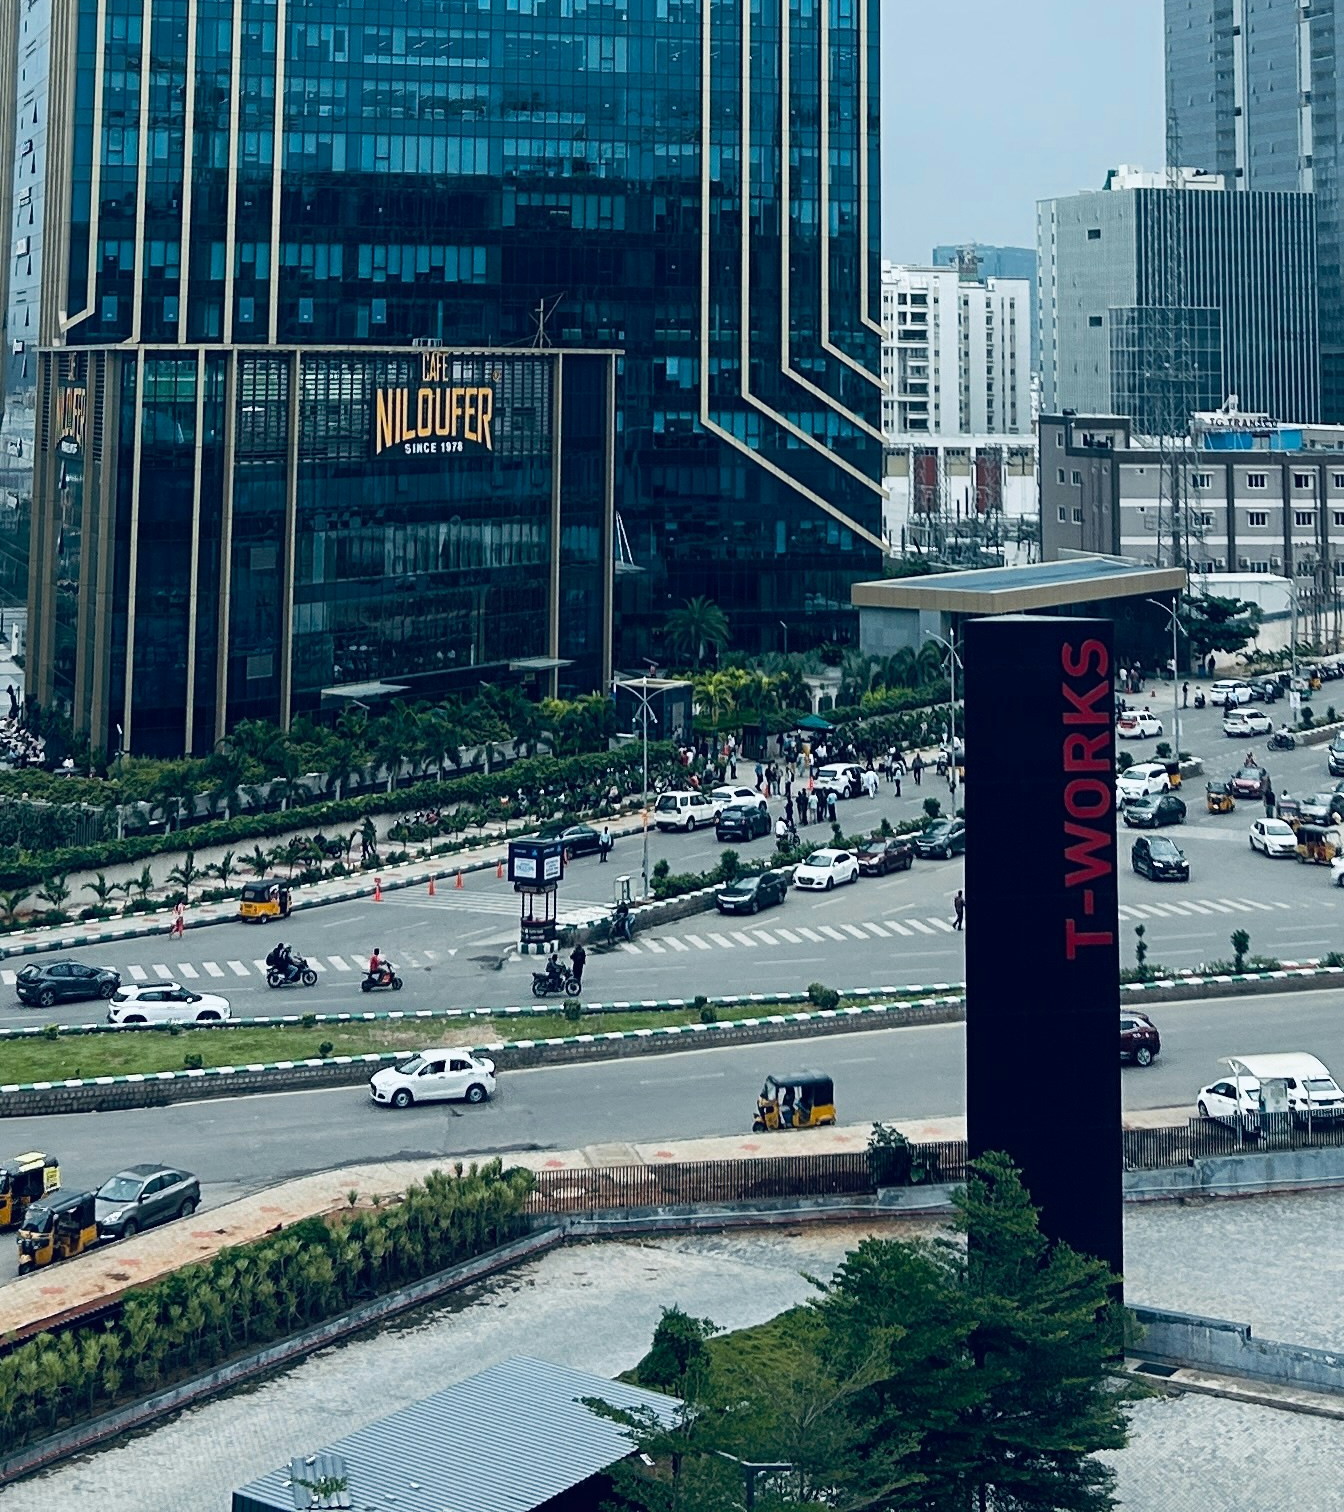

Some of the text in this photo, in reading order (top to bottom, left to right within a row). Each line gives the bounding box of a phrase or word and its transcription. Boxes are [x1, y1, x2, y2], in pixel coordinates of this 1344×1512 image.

[376, 387, 493, 455] NILOUFER
[404, 440, 464, 454] SINCE 1978
[1061, 638, 1114, 960] T-WORKS
